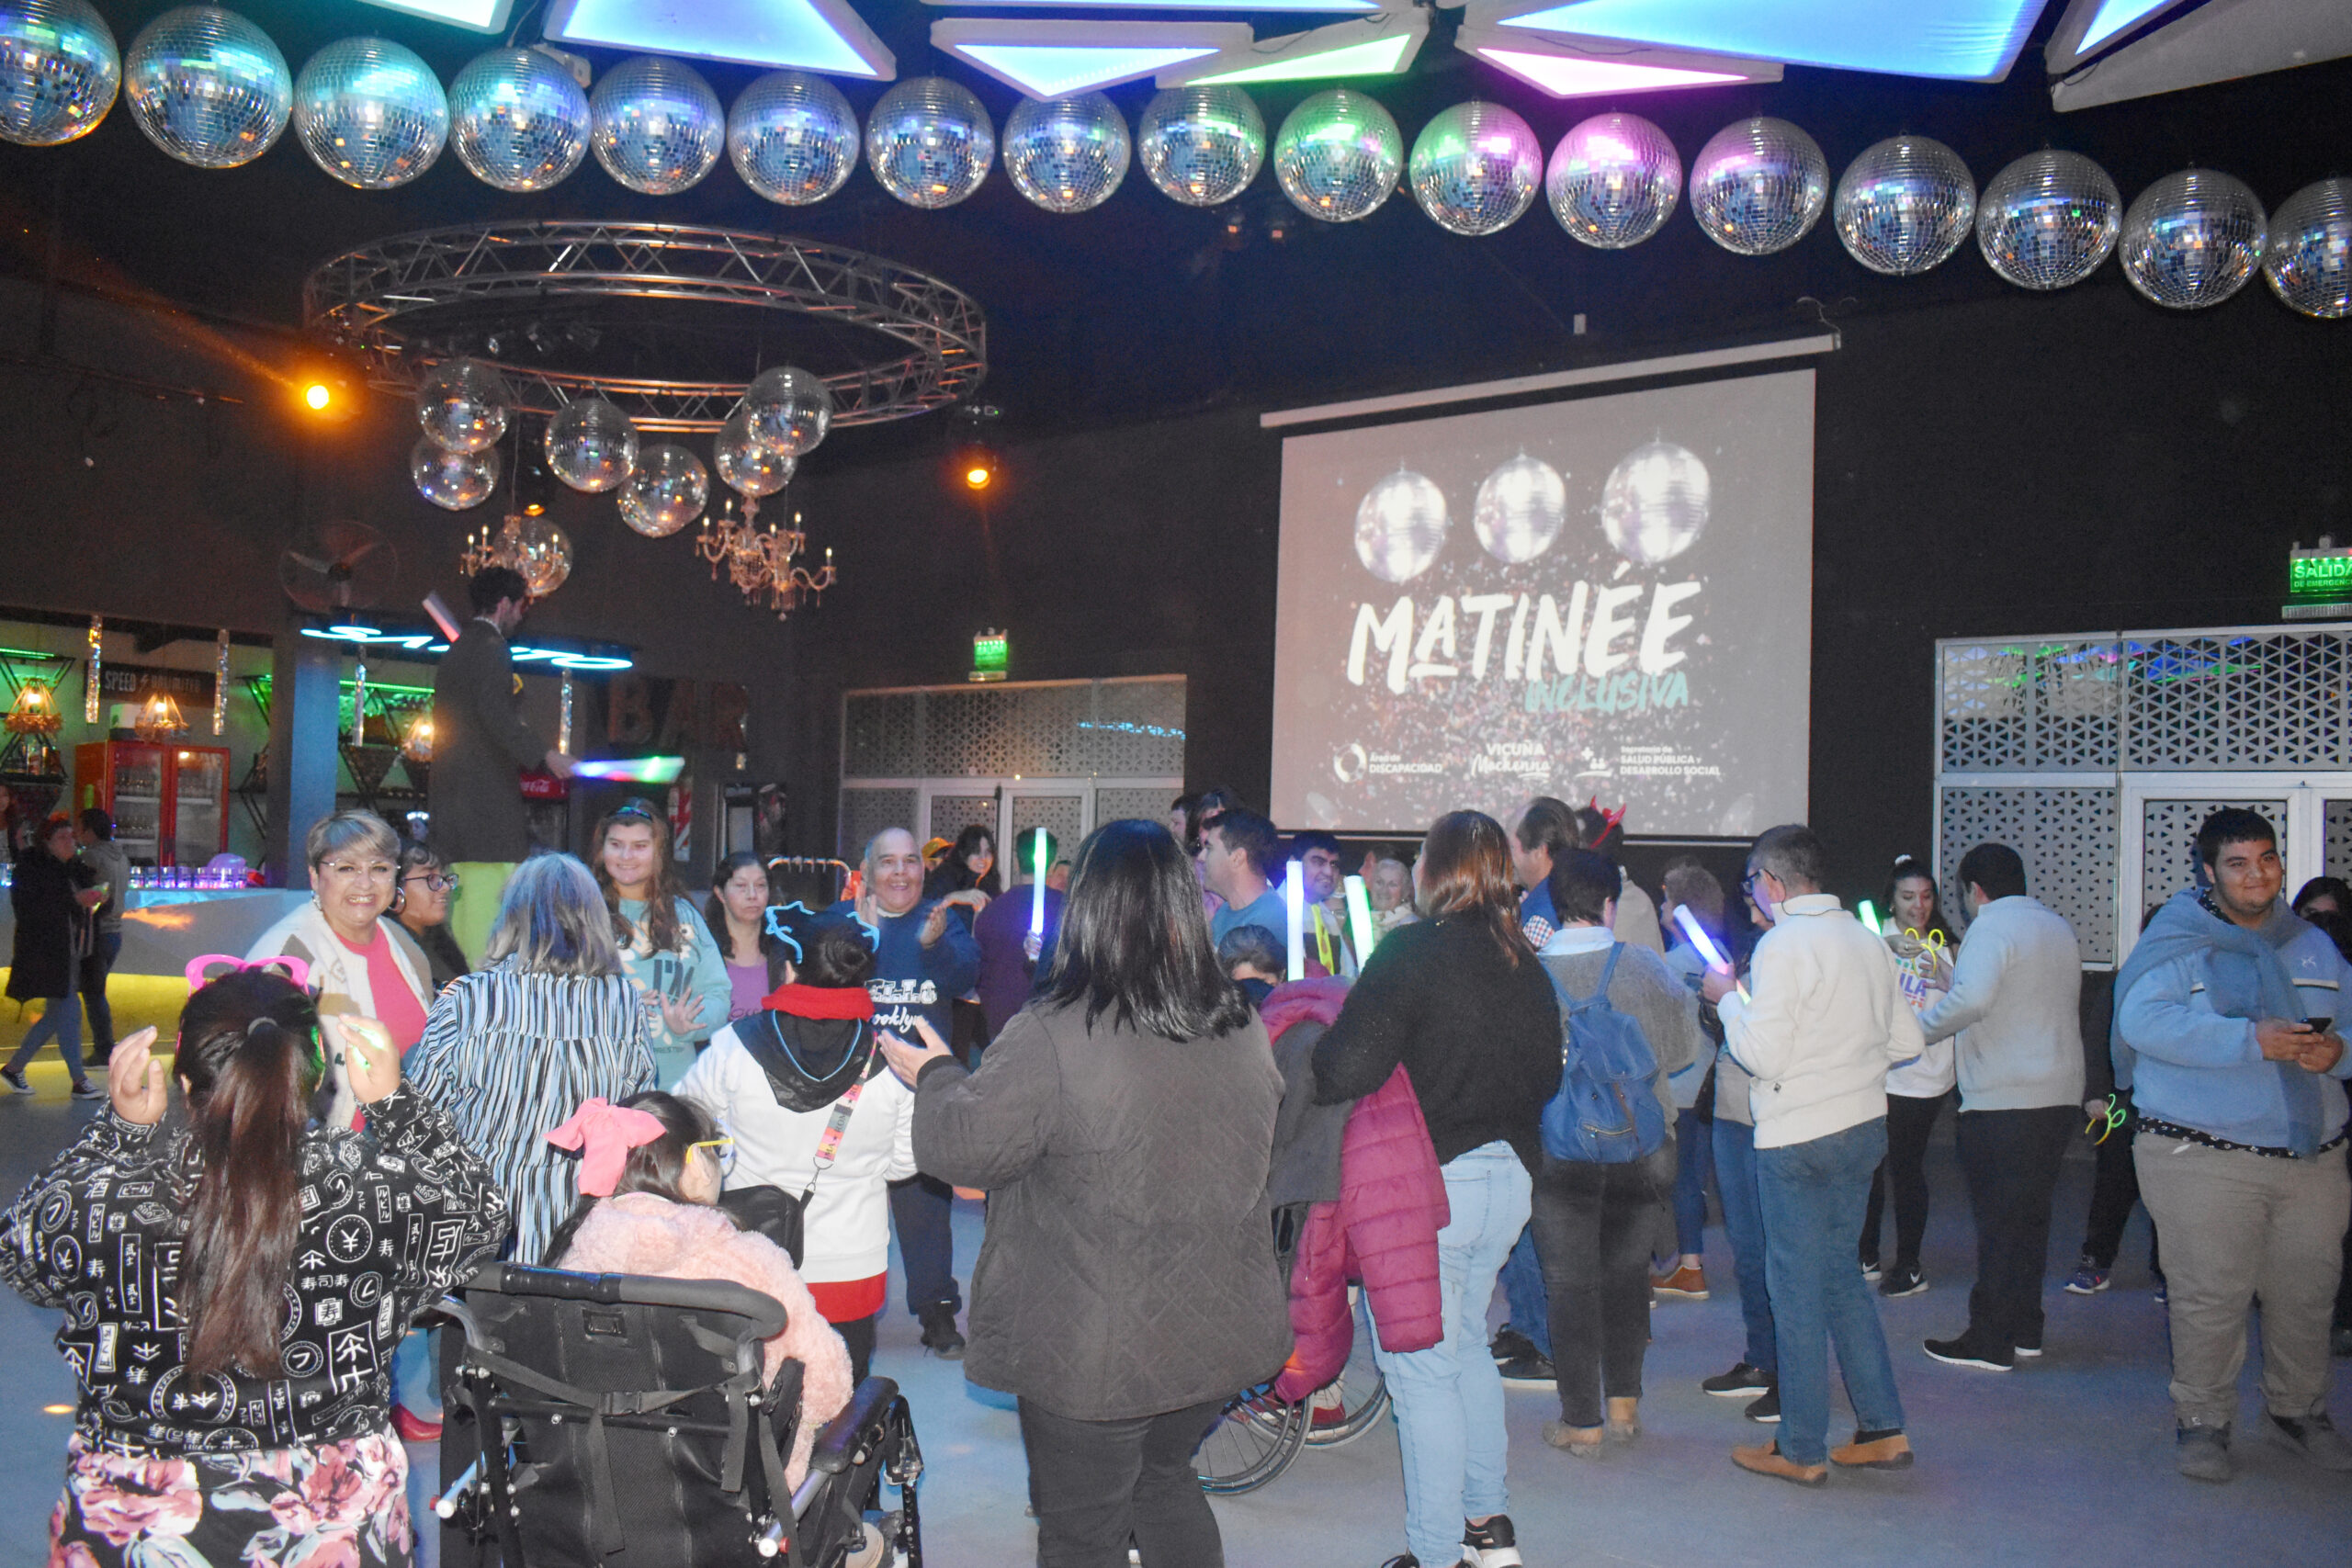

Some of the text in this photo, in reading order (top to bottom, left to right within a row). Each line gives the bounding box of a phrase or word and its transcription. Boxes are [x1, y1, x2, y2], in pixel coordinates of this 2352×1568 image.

[1347, 559, 1702, 694] MATINÉE
[104, 670, 136, 693] SPEED
[1524, 671, 1689, 713] INCLUSIVA
[608, 675, 749, 751] BAR
[1485, 739, 1546, 757] VICUÑA
[1620, 755, 1652, 764] SALUD
[1369, 763, 1443, 774] DISCAPACIDAD
[1471, 753, 1551, 777] Mackenna
[1620, 766, 1721, 776] DESARROLLO SOCIAL
